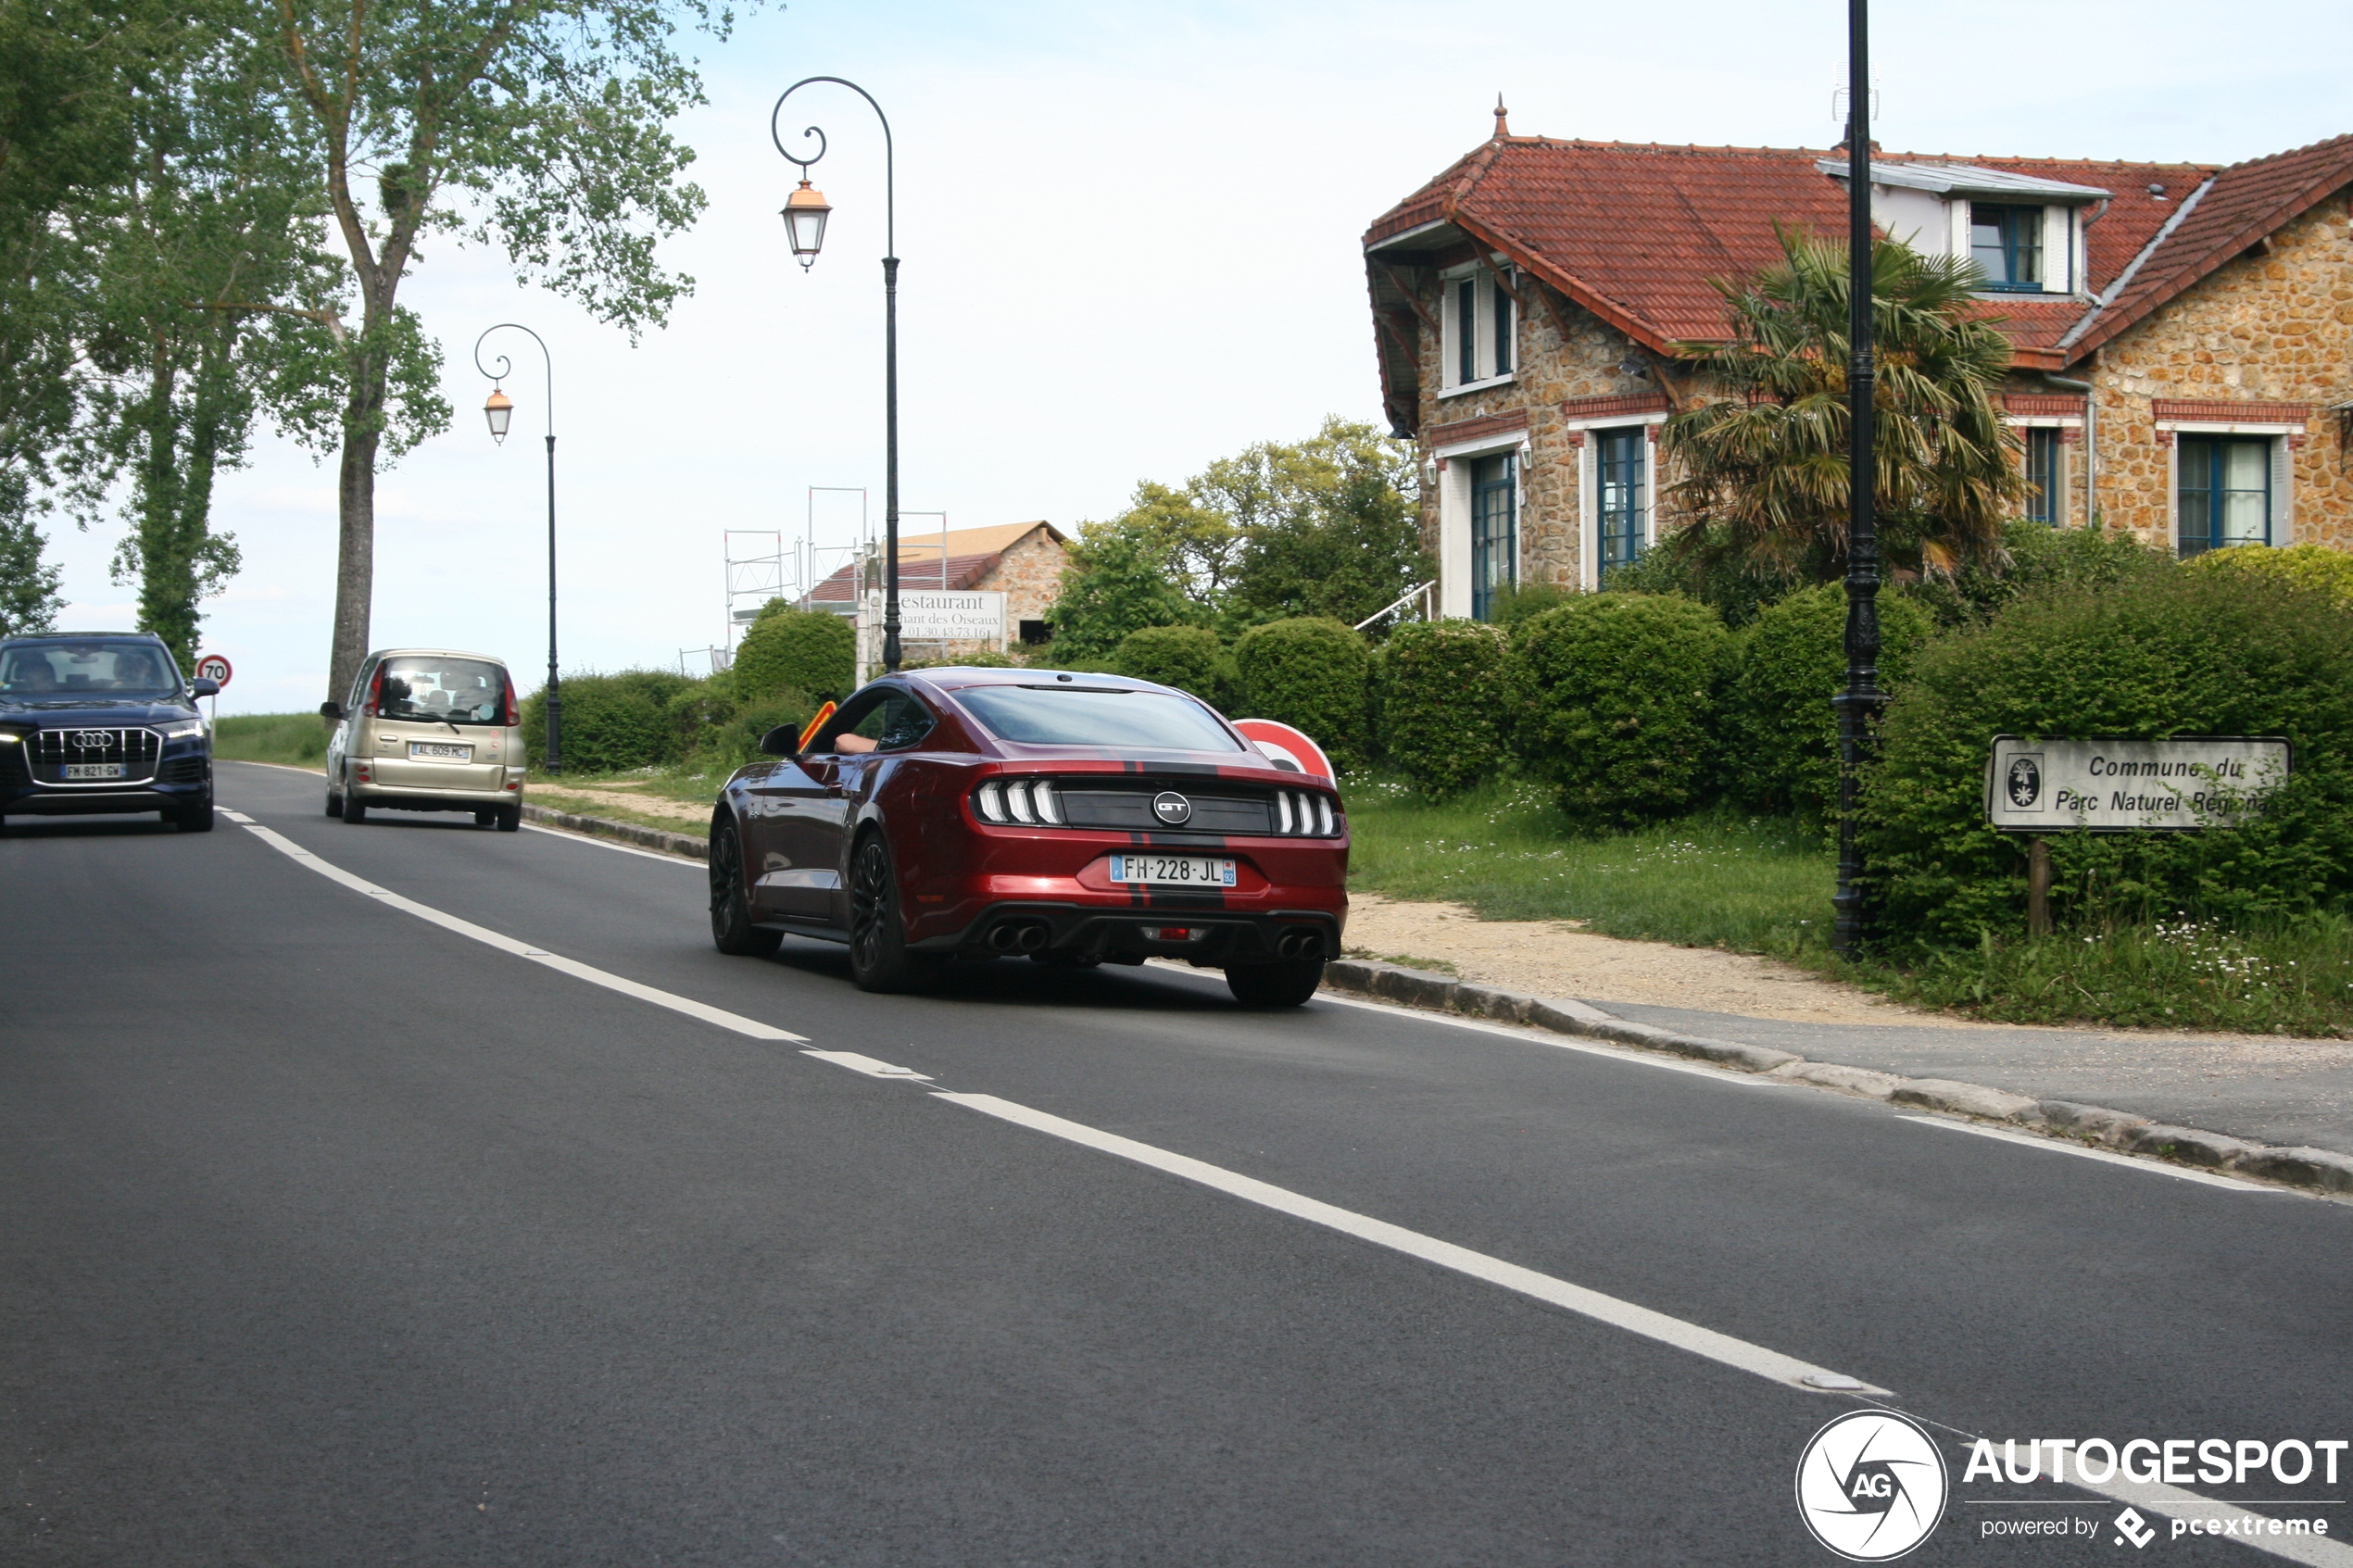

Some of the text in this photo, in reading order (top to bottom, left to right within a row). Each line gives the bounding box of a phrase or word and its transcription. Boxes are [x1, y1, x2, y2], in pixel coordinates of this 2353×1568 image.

[900, 596, 985, 609] estaurant
[900, 612, 925, 624] hant
[928, 612, 949, 624] des
[951, 612, 1000, 625] Oiseaux
[205, 665, 225, 679] 70
[2216, 758, 2242, 778] du
[1158, 802, 1187, 811] GT
[2055, 790, 2098, 810] Parc
[2110, 790, 2181, 811] Naturel
[1125, 858, 1221, 882] FH-228-JL
[1224, 872, 1234, 883] 92
